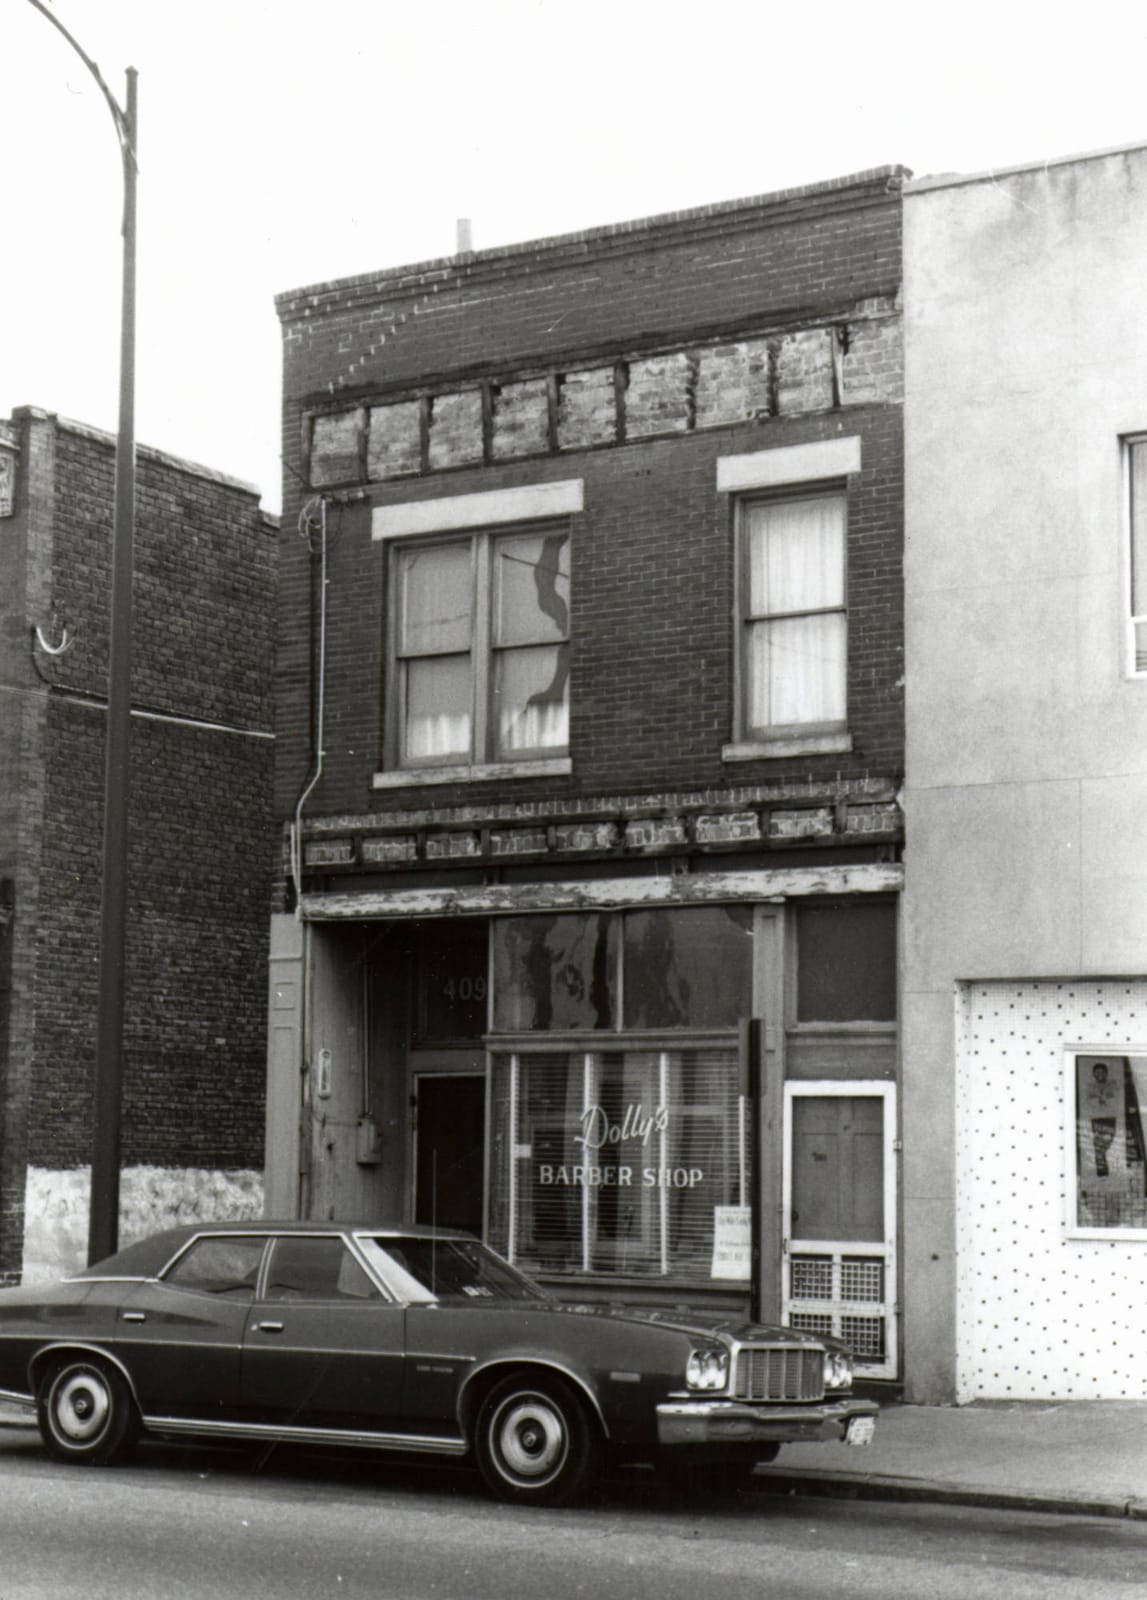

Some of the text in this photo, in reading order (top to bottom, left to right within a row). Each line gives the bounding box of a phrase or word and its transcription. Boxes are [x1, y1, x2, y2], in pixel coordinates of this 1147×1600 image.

[443, 977, 486, 1001] 409
[573, 1104, 669, 1150] Dolly's
[539, 1165, 703, 1188] BARBER SHOP
